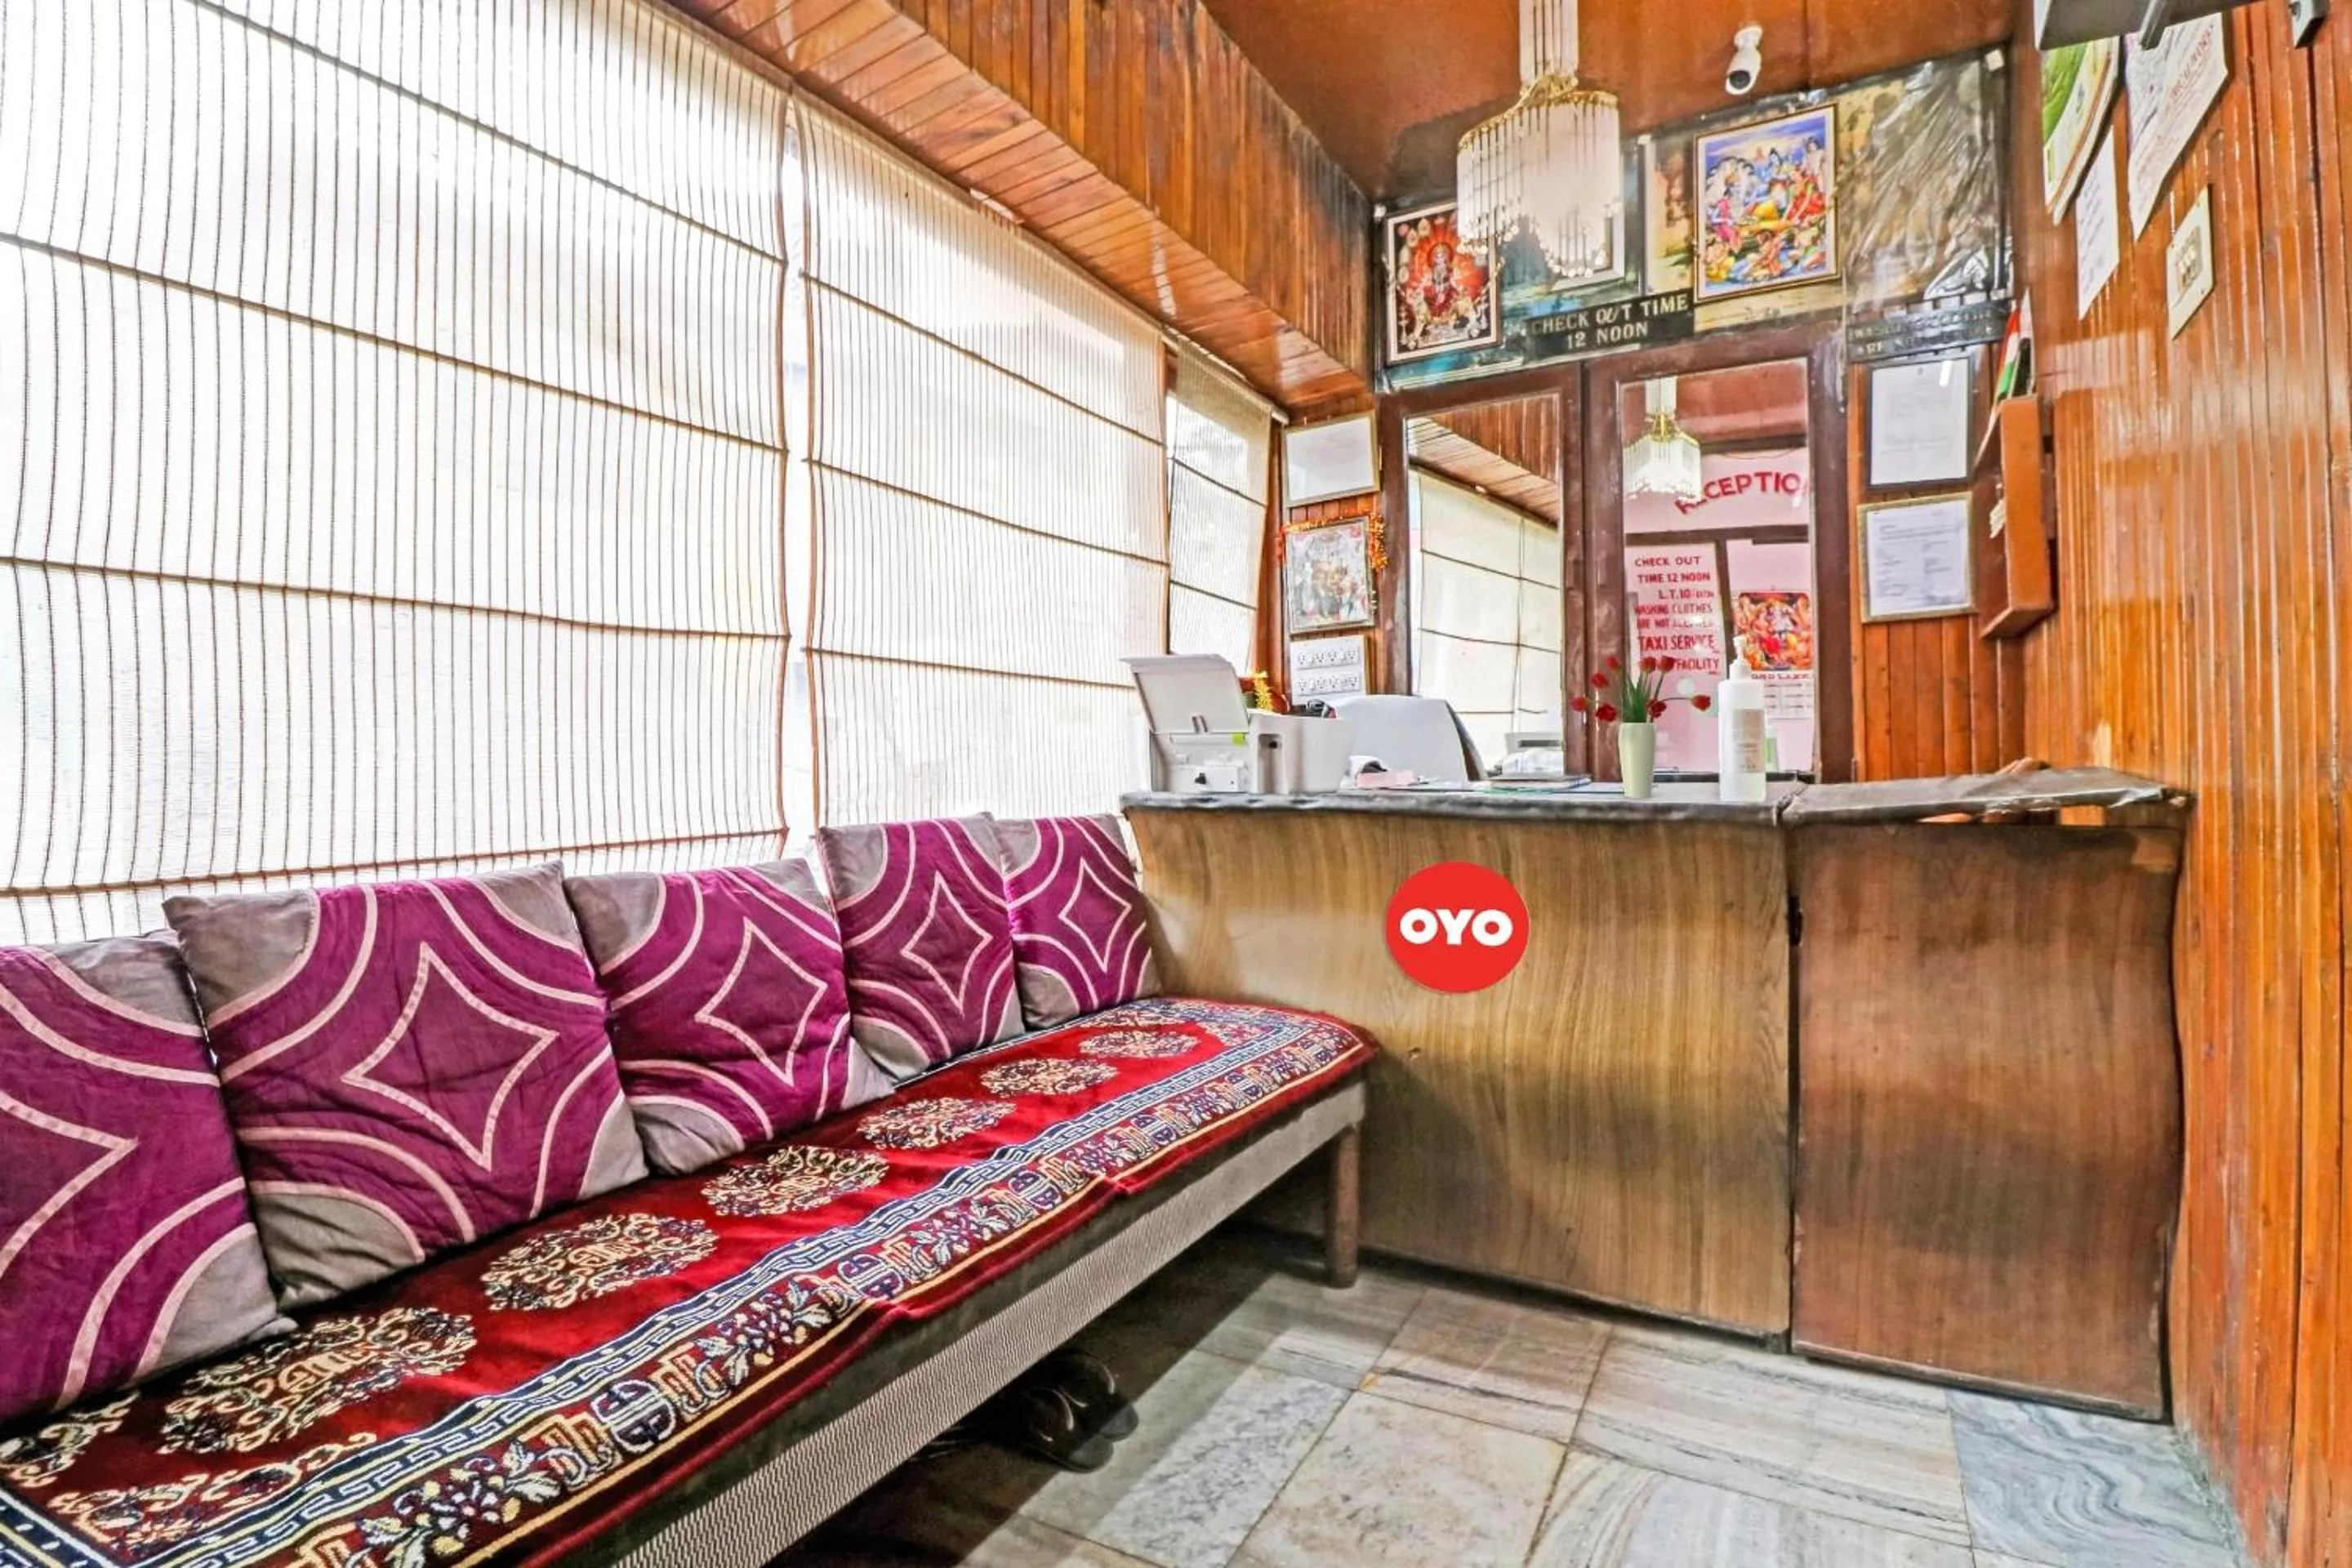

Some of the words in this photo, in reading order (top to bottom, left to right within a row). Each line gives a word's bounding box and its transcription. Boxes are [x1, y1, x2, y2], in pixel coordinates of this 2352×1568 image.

[1531, 311, 1589, 335] CHECK
[1595, 303, 1633, 324] OUT
[1640, 293, 1689, 317] TIME
[1566, 332, 1586, 350] 12
[1596, 321, 1648, 345] NOON
[1634, 557, 1669, 567] CHECK
[1675, 555, 1701, 565] OUT
[1637, 573, 1664, 584] TIME
[1667, 572, 1678, 582] 12
[1681, 572, 1711, 582] NOON
[1671, 604, 1713, 614] CLOTHES
[1638, 635, 1668, 651] TAXI
[1399, 907, 1513, 947] OYO
